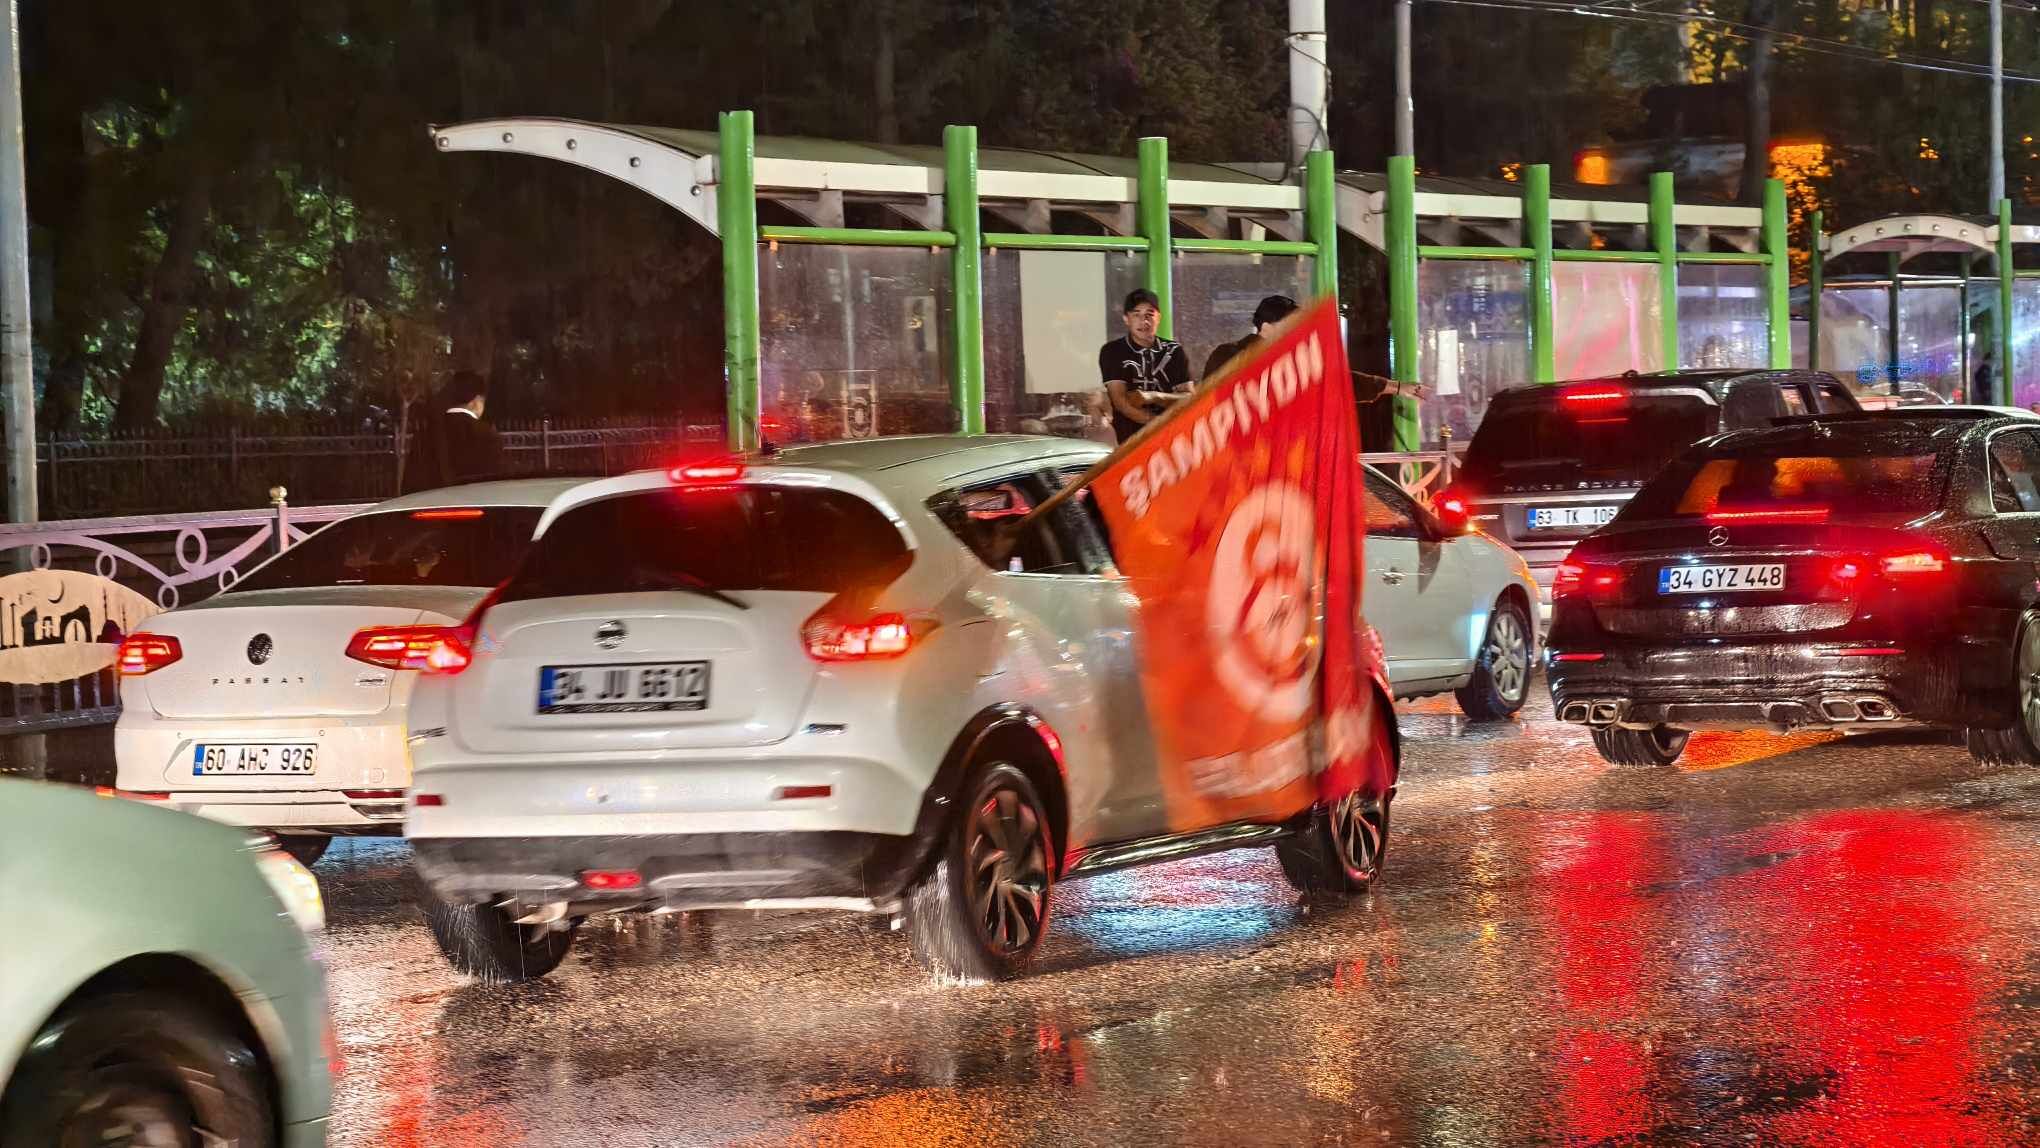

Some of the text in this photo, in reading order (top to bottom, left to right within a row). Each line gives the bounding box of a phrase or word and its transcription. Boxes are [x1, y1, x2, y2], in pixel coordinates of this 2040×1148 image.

[1538, 510, 1552, 524] 63
[1565, 509, 1579, 524] TK
[1671, 566, 1781, 589] 34 GYZ 448
[553, 671, 586, 701] 34
[205, 747, 314, 771] 60 AHC 926
